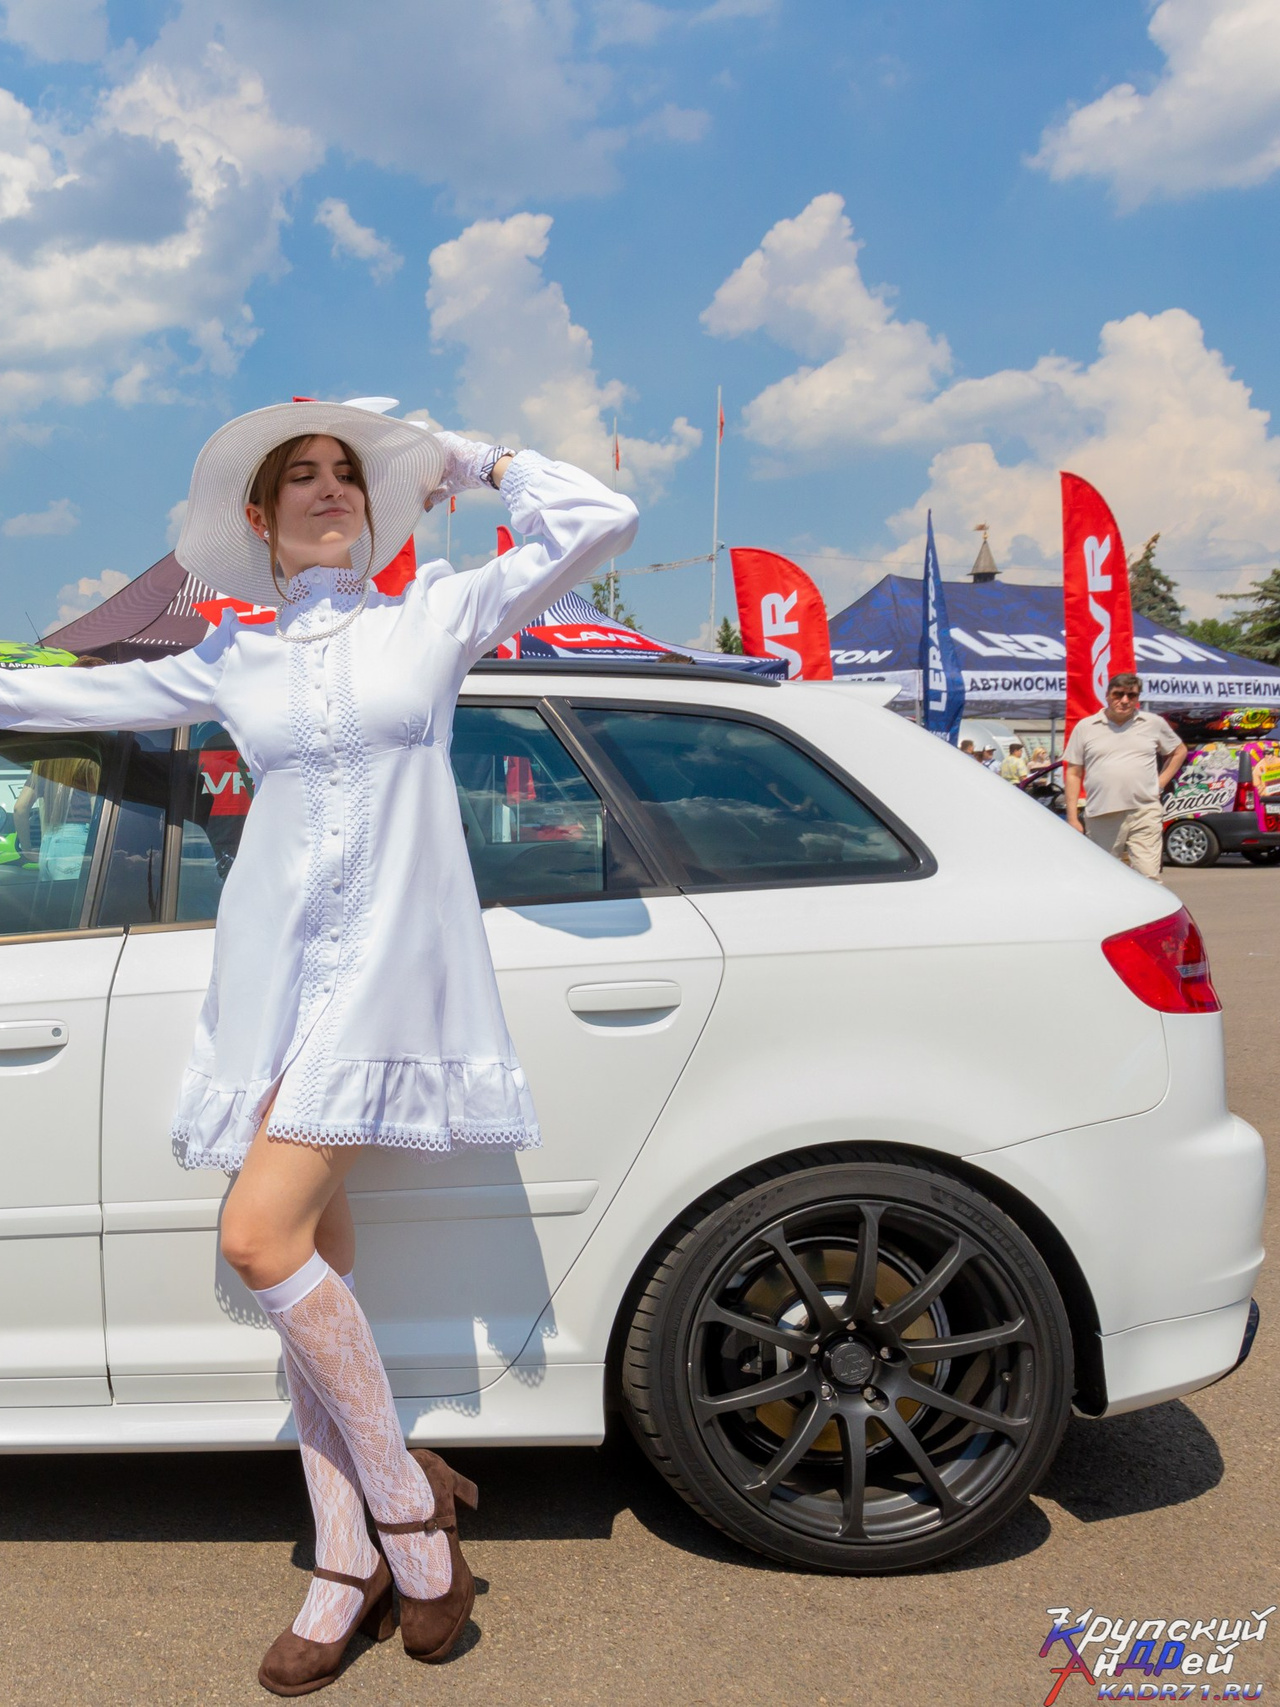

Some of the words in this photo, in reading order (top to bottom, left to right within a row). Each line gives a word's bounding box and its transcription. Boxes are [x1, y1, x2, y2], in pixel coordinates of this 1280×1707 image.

[554, 631, 642, 645] LAVR
[950, 627, 1228, 663] LERON
[1148, 677, 1199, 694] МОЙКИ
[1203, 681, 1213, 694] И
